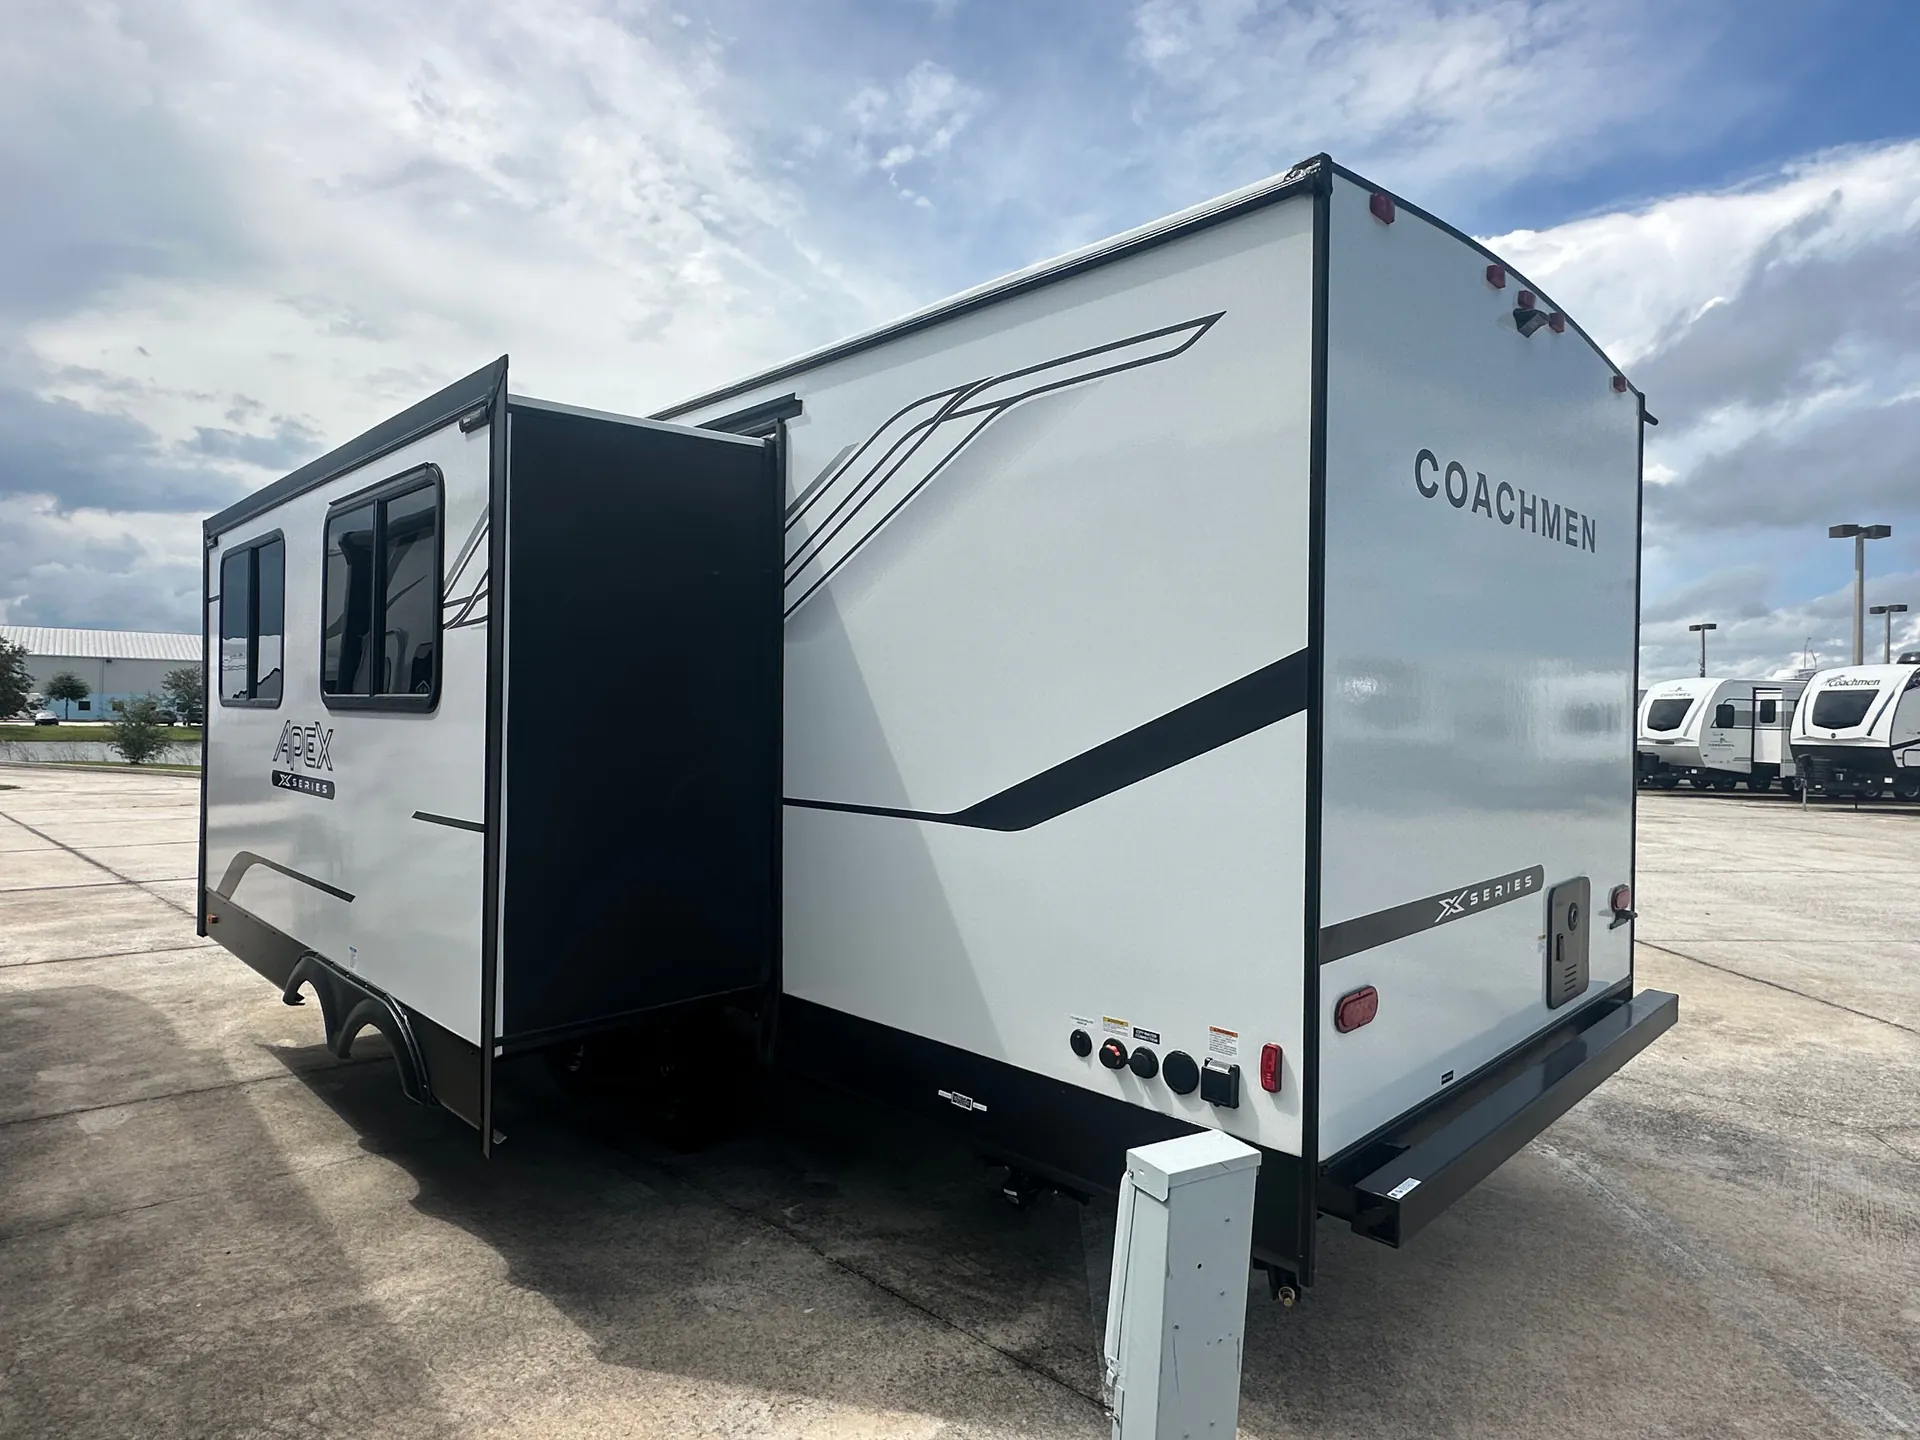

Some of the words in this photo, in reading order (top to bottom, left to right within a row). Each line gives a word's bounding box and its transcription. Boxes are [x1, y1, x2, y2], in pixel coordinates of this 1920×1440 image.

[1414, 448, 1596, 554] COACHMEN
[1827, 677, 1881, 688] Coachmen
[273, 720, 334, 771] APEX
[292, 778, 328, 794] SERIES
[1469, 875, 1533, 906] SERIES
